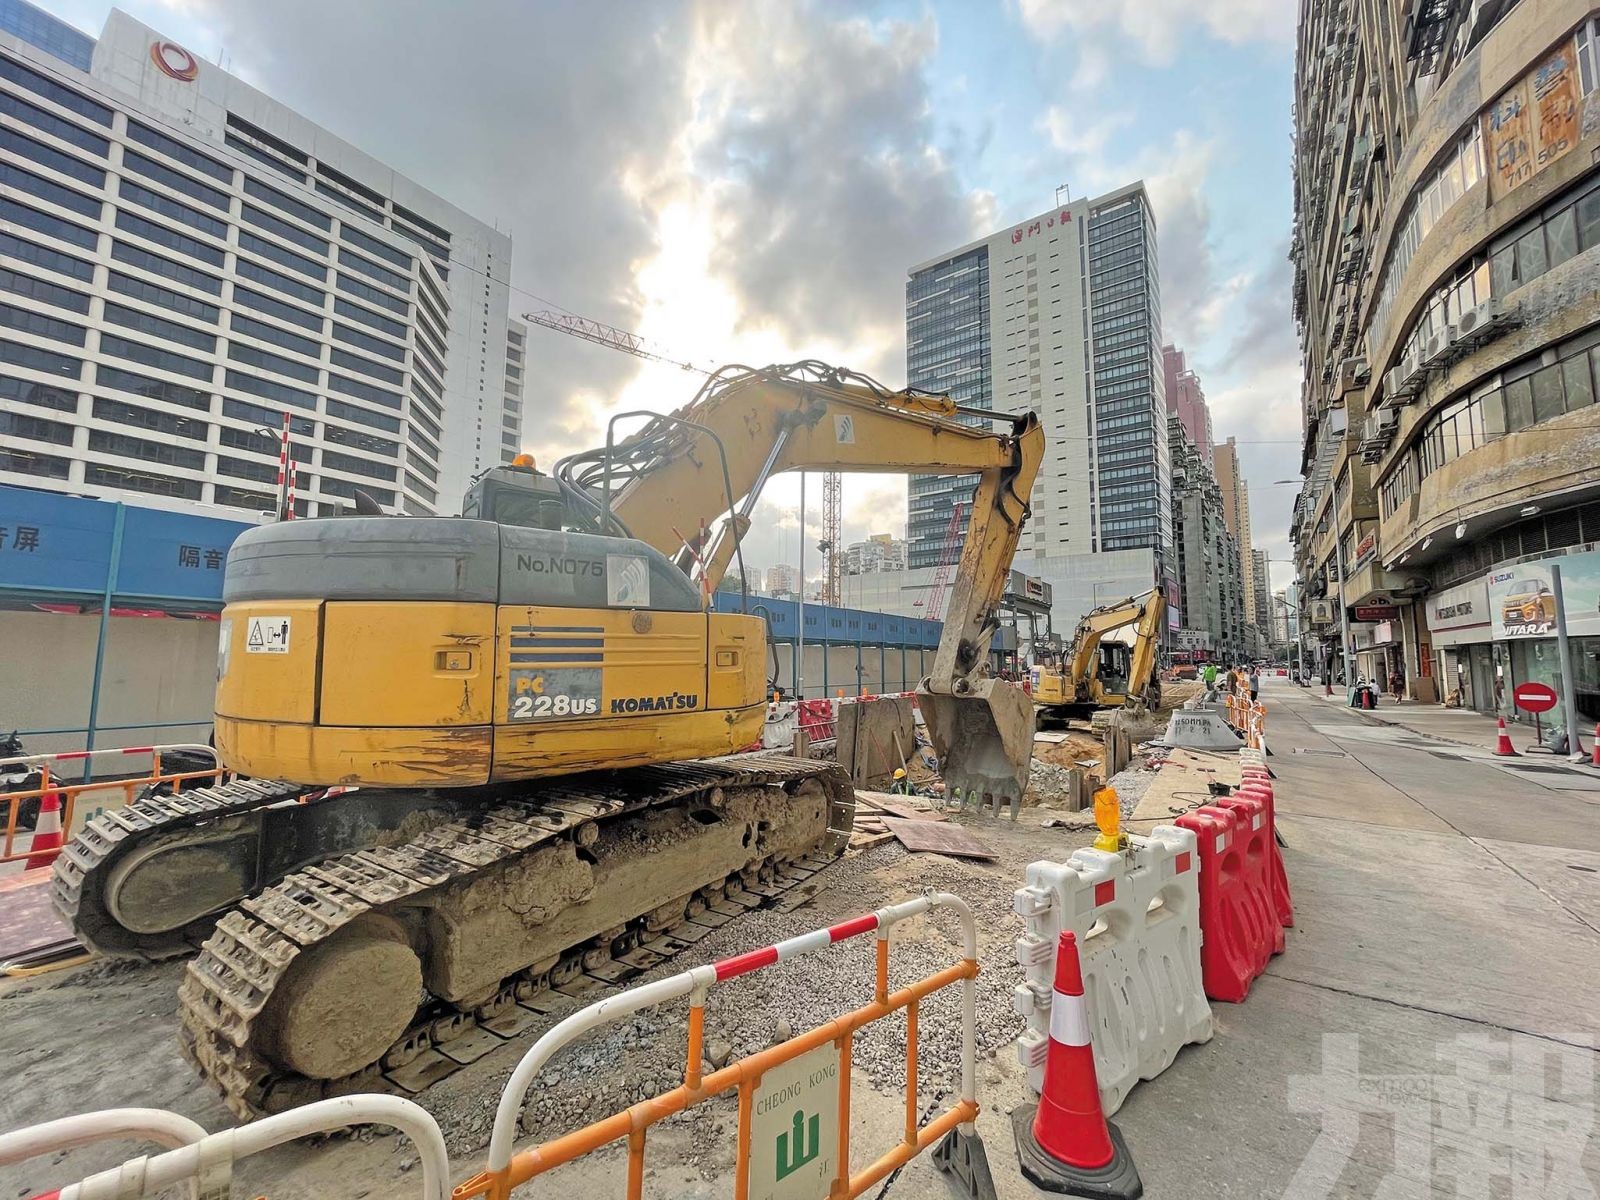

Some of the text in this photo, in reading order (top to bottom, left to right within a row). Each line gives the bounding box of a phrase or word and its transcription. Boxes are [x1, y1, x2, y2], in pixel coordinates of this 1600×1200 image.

[1494, 572, 1514, 583] SUZUKI
[1503, 622, 1551, 636] VITARA
[515, 676, 544, 694] PC
[611, 692, 698, 714] KOMATSU
[756, 1063, 837, 1116] CHEONG KONG
